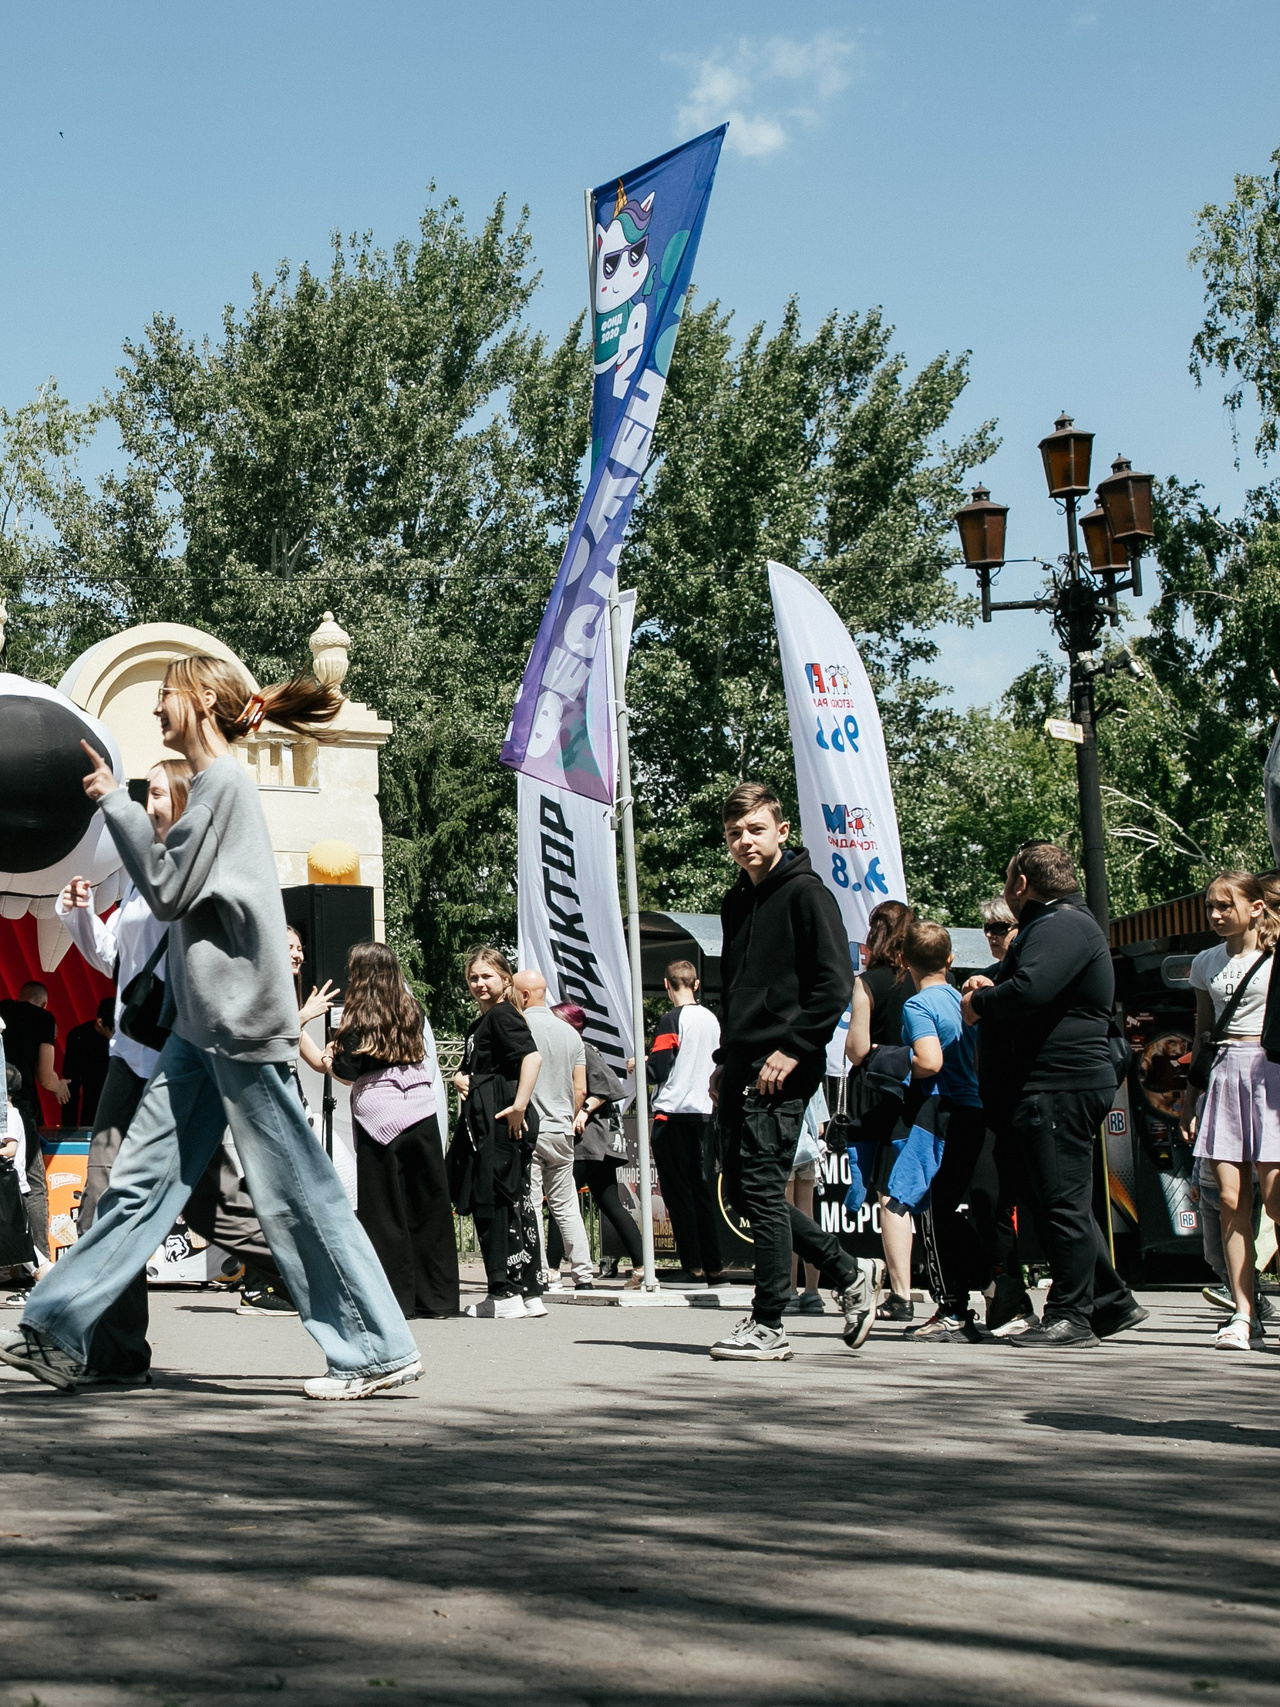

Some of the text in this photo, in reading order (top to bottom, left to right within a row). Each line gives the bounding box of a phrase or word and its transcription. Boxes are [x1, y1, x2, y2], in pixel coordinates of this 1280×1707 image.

[601, 327, 620, 344] 2020
[1111, 1112, 1124, 1131] RB
[1182, 1213, 1194, 1226] RB
